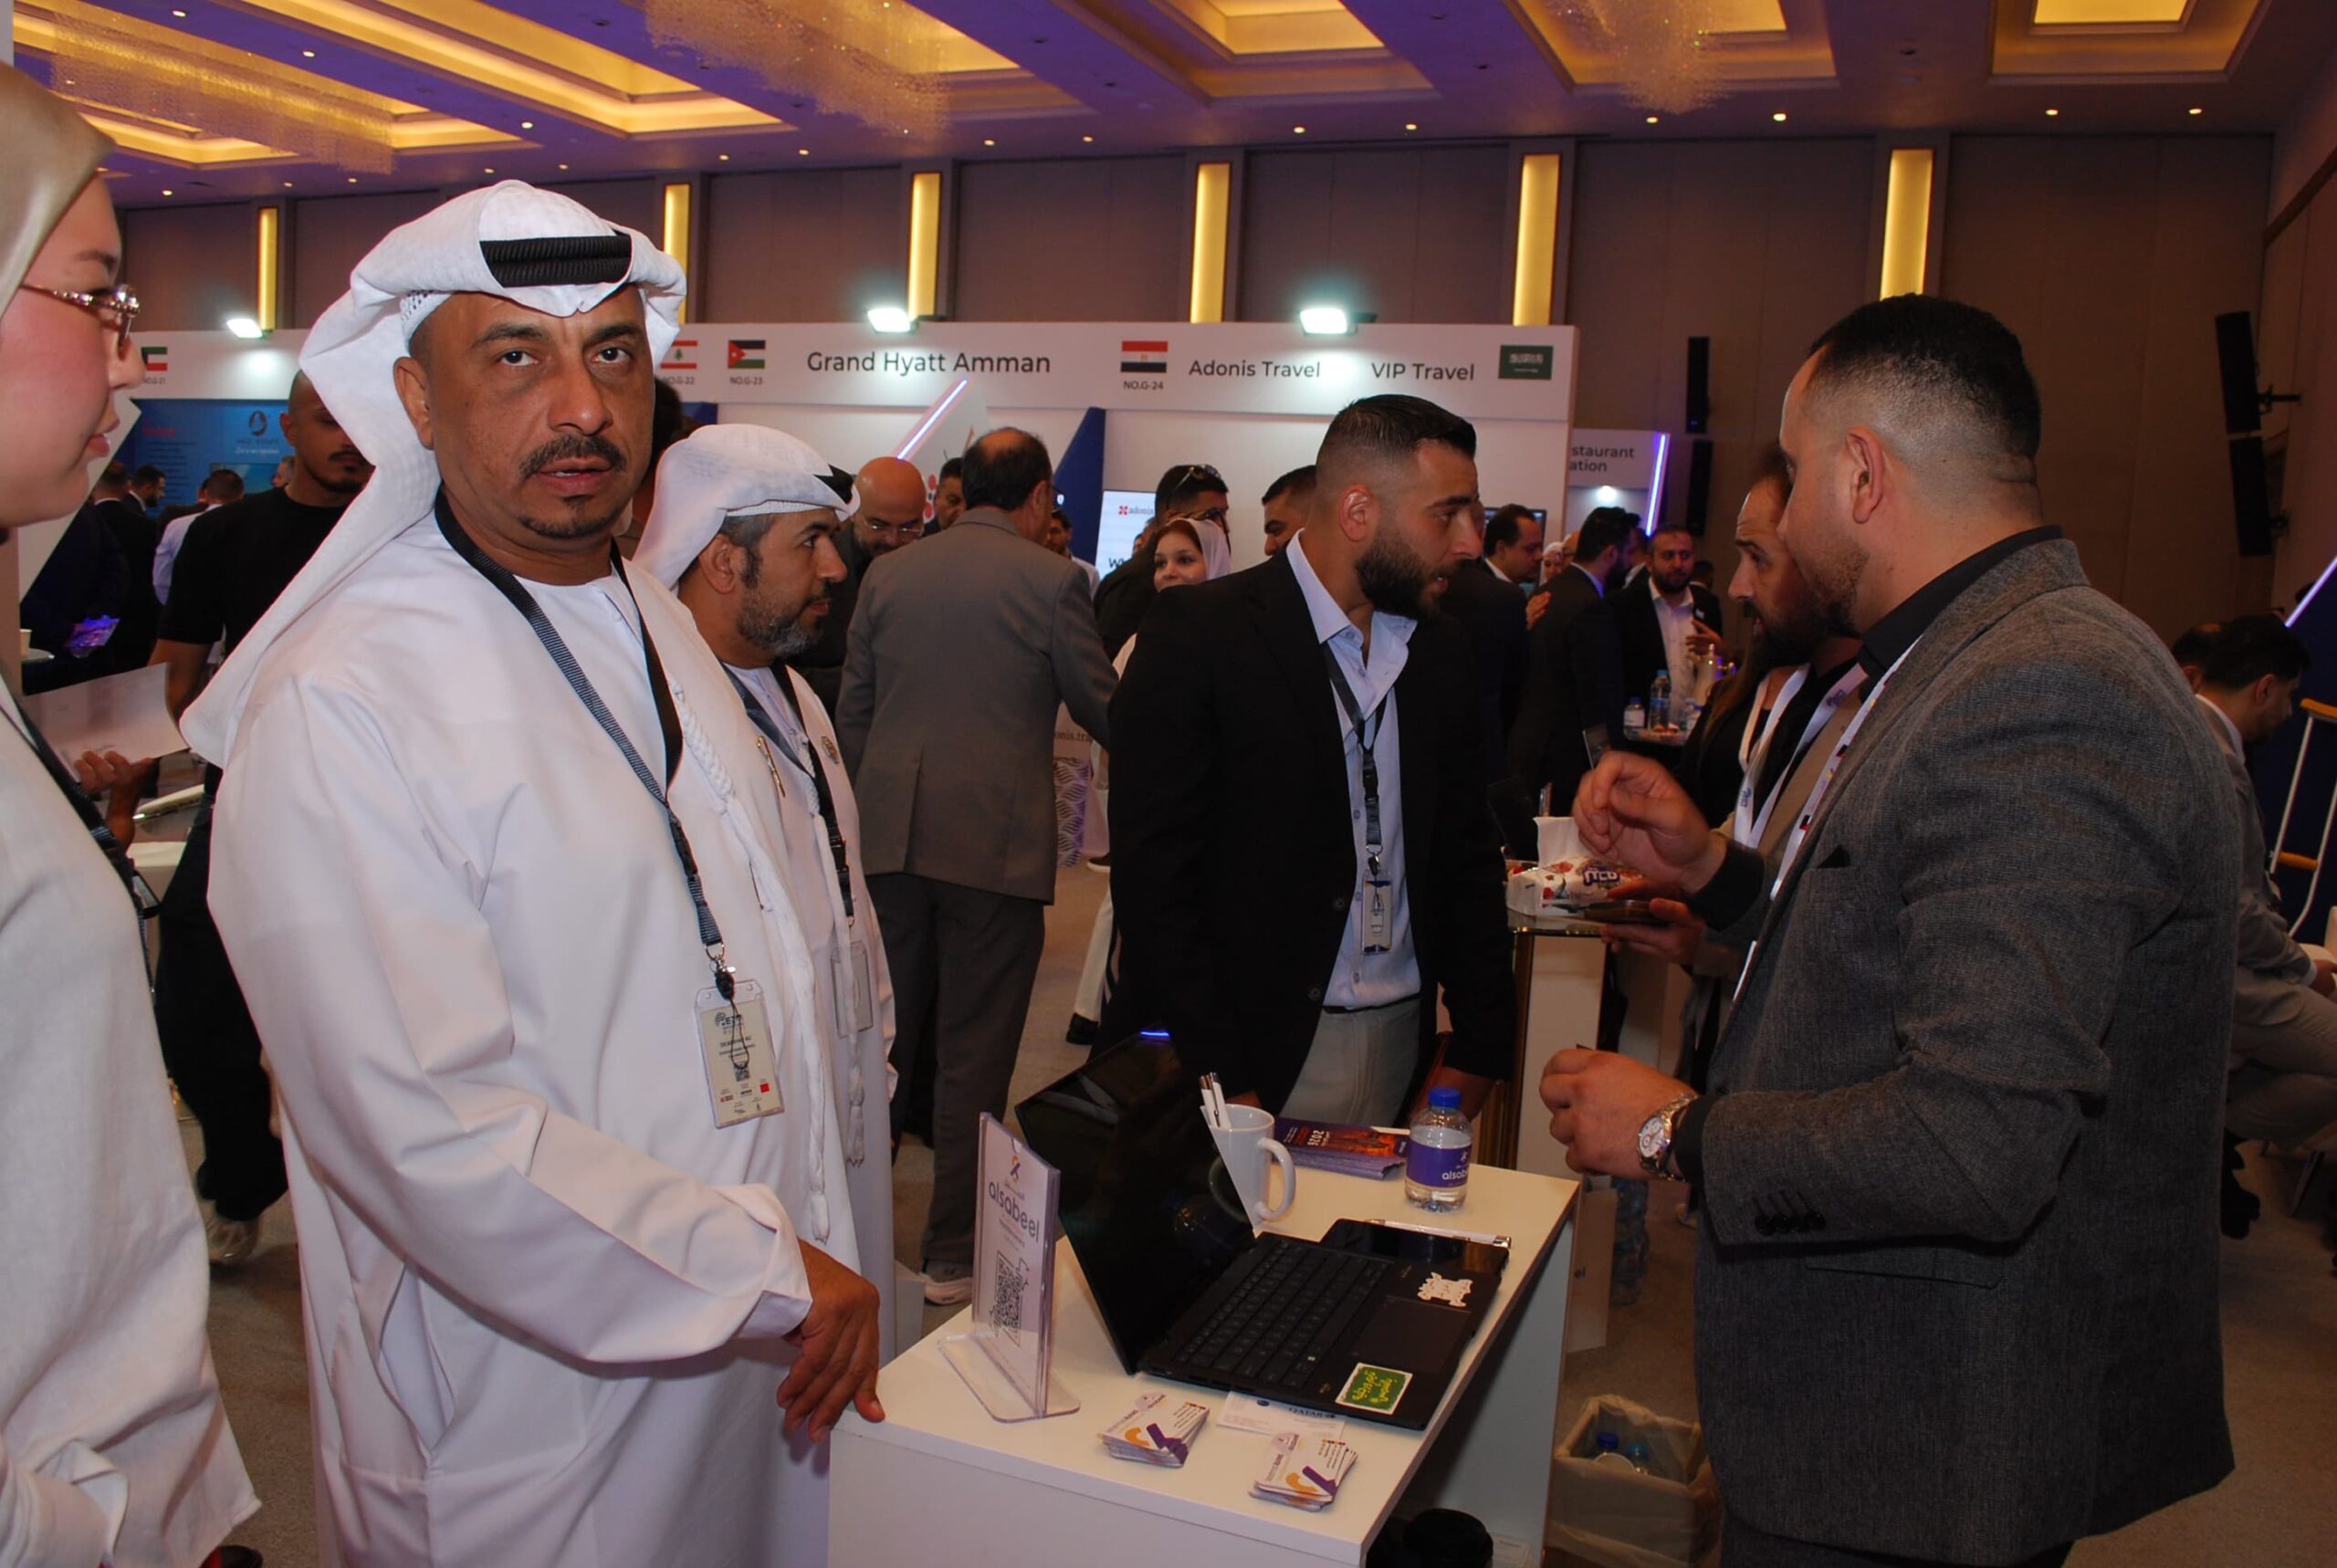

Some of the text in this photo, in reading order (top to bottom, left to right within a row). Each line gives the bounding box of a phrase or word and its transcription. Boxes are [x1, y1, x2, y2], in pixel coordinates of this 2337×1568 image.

[807, 351, 1051, 375] Grand Hyatt Amman
[1189, 360, 1321, 378] Adonis Travel
[1371, 363, 1475, 381] VIP Travel
[1123, 381, 1164, 392] NO.G-24
[1572, 445, 1634, 458] staurant
[1569, 460, 1608, 471] ation
[989, 1182, 1040, 1242] alsabeel
